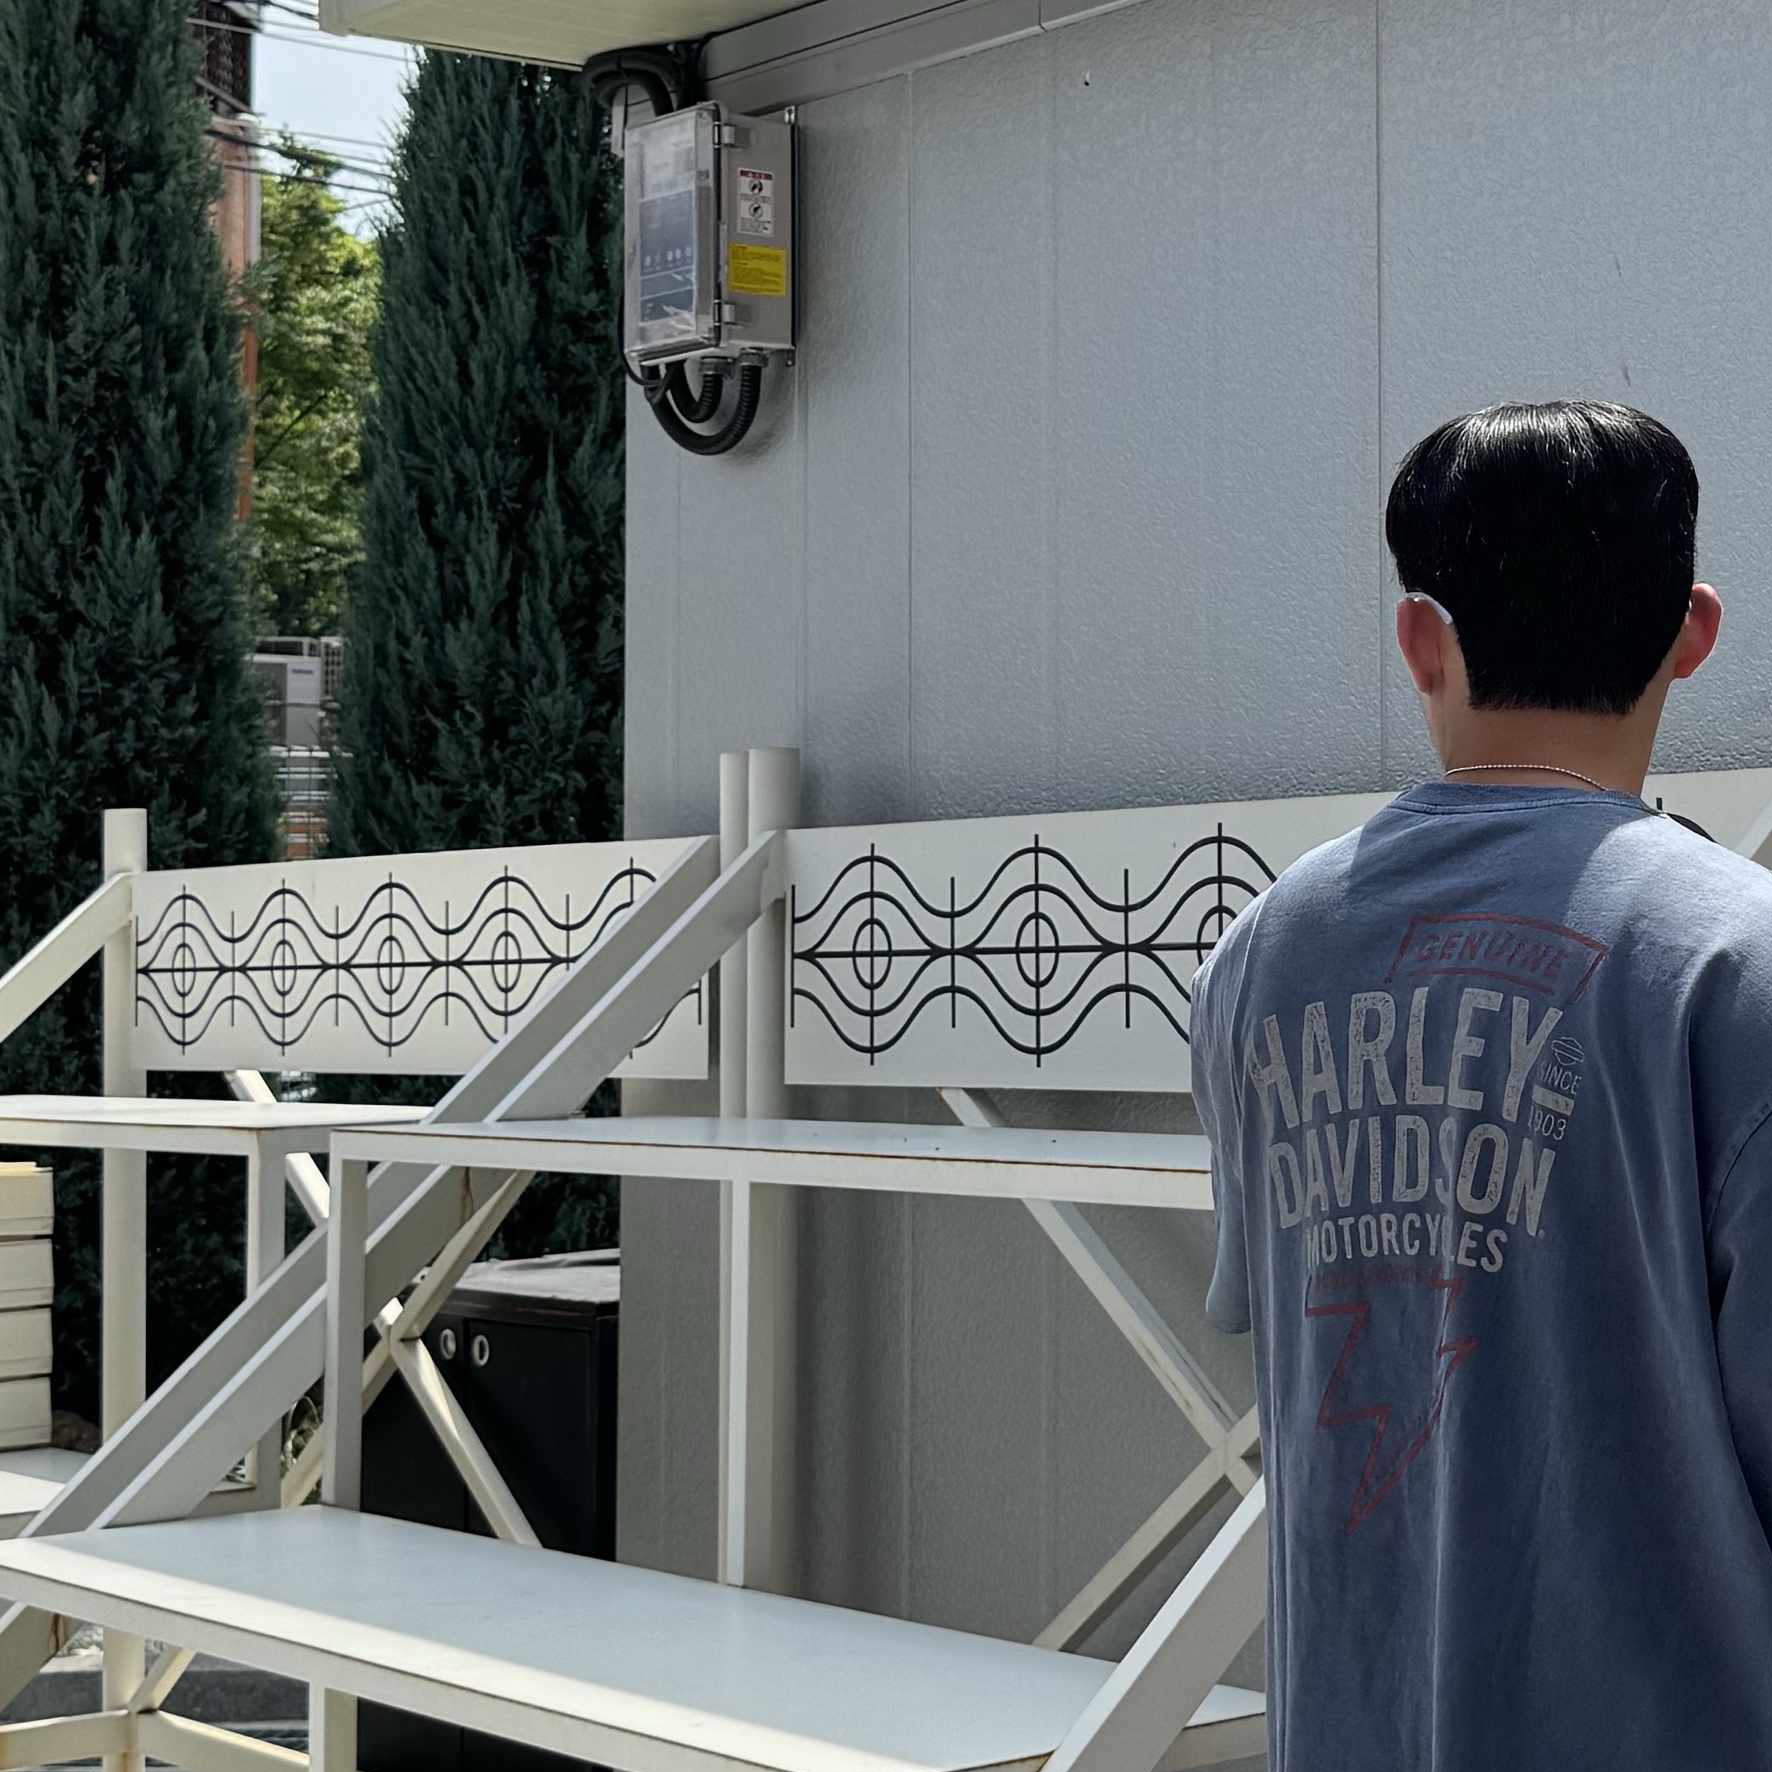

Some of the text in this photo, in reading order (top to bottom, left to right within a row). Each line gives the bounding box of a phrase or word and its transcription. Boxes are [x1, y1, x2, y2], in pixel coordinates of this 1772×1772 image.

[1414, 929, 1567, 980] GENUINE
[1250, 986, 1563, 1129] HARLEY
[1540, 1061, 1582, 1095] SINCE
[1528, 1105, 1567, 1140] 1903
[1268, 1114, 1556, 1237] DAVIDSON
